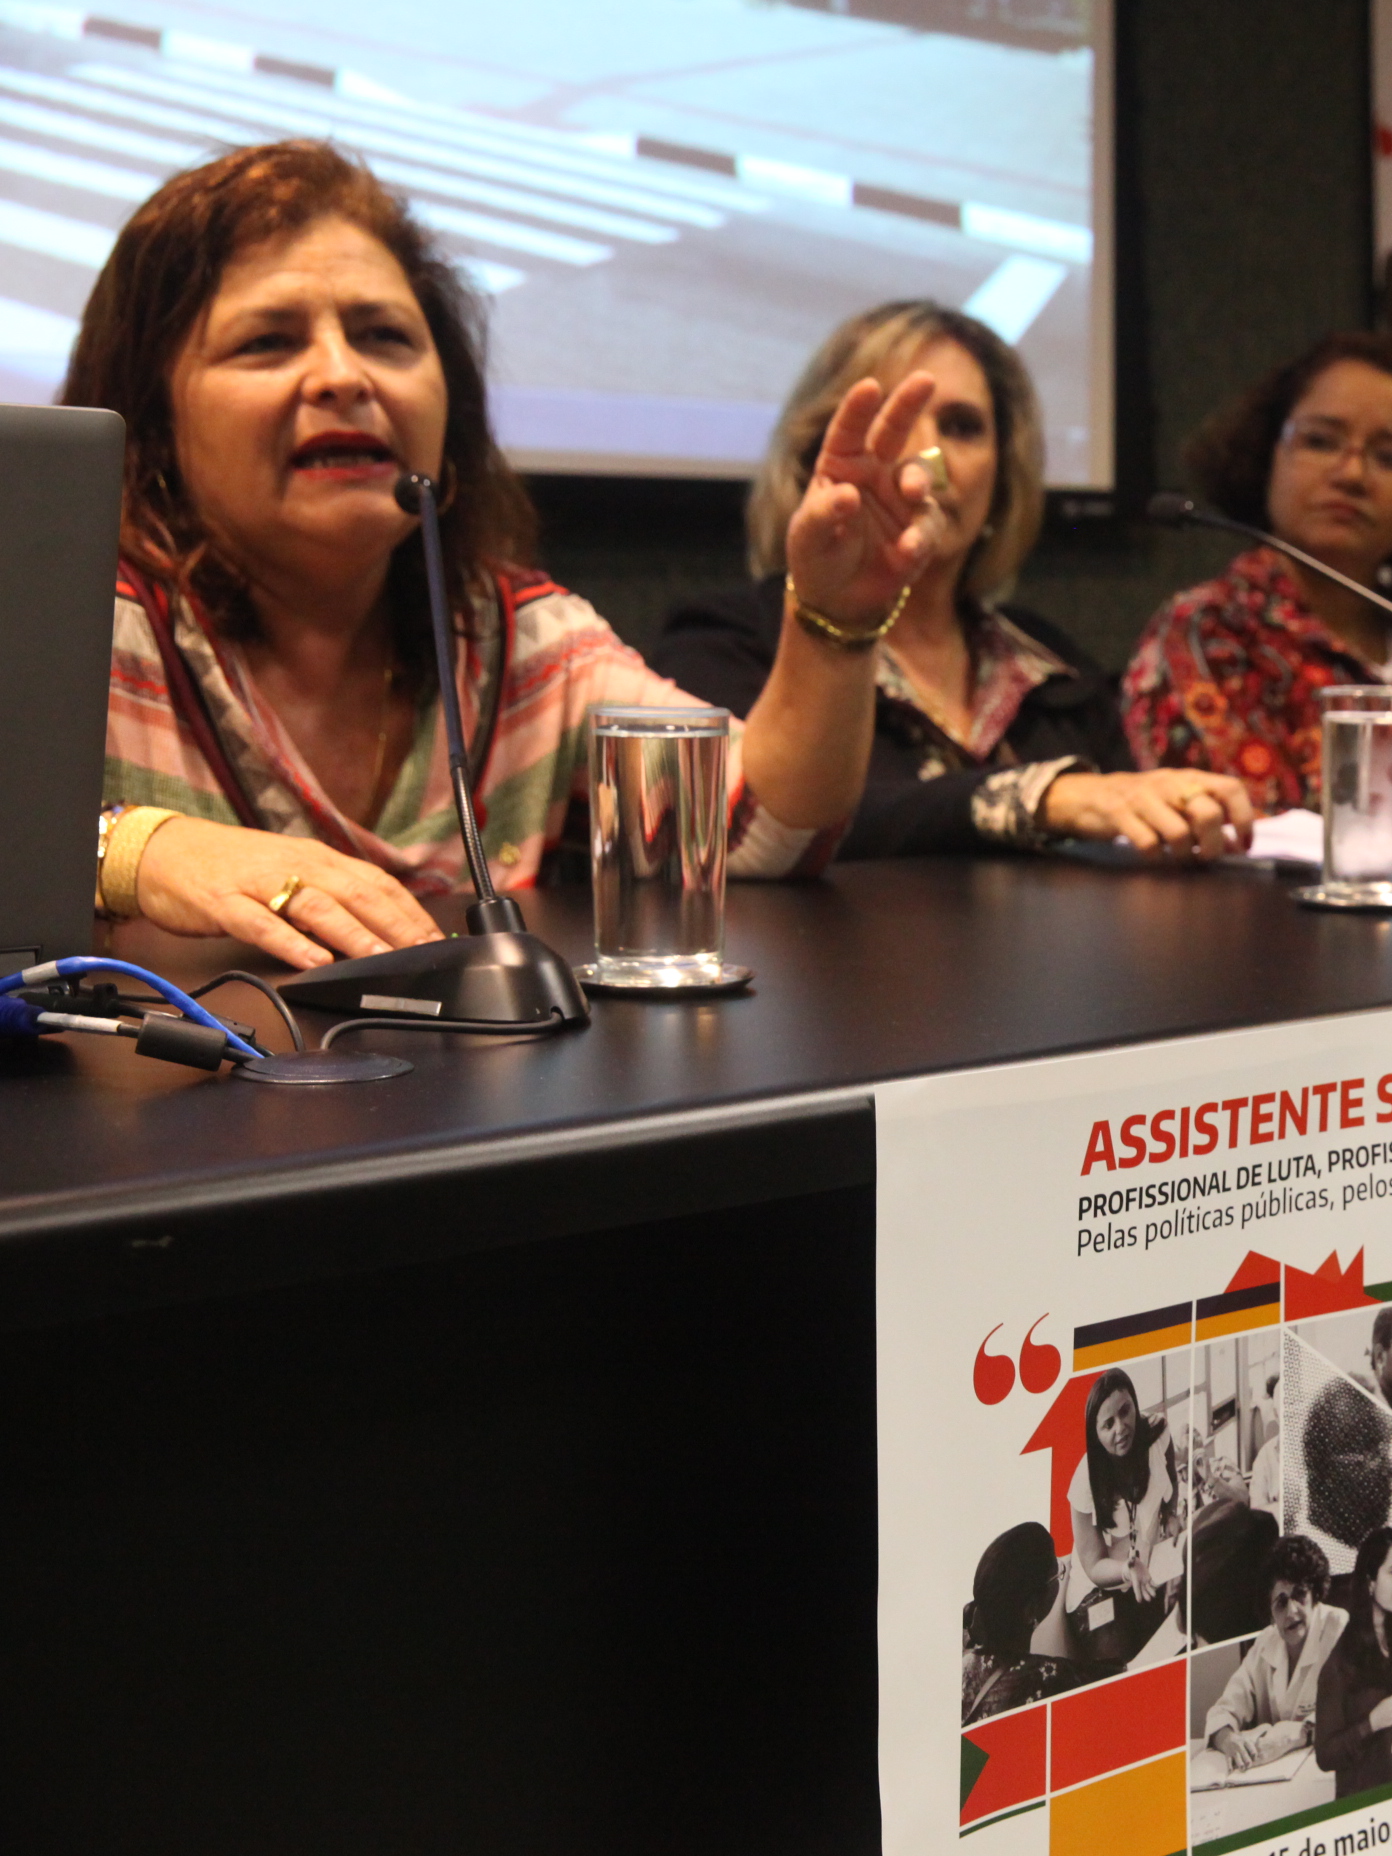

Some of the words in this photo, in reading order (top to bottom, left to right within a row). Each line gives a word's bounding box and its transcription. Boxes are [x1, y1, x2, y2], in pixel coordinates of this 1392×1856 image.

[1080, 1078, 1365, 1176] ASSISTENTE
[1077, 1220, 1138, 1258] Pelas
[1144, 1203, 1235, 1251] políticas
[1241, 1183, 1335, 1230] públicas,
[1078, 1174, 1232, 1222] PROFISSIONAL
[1236, 1163, 1263, 1191] DE
[1267, 1153, 1322, 1184] LUTA,
